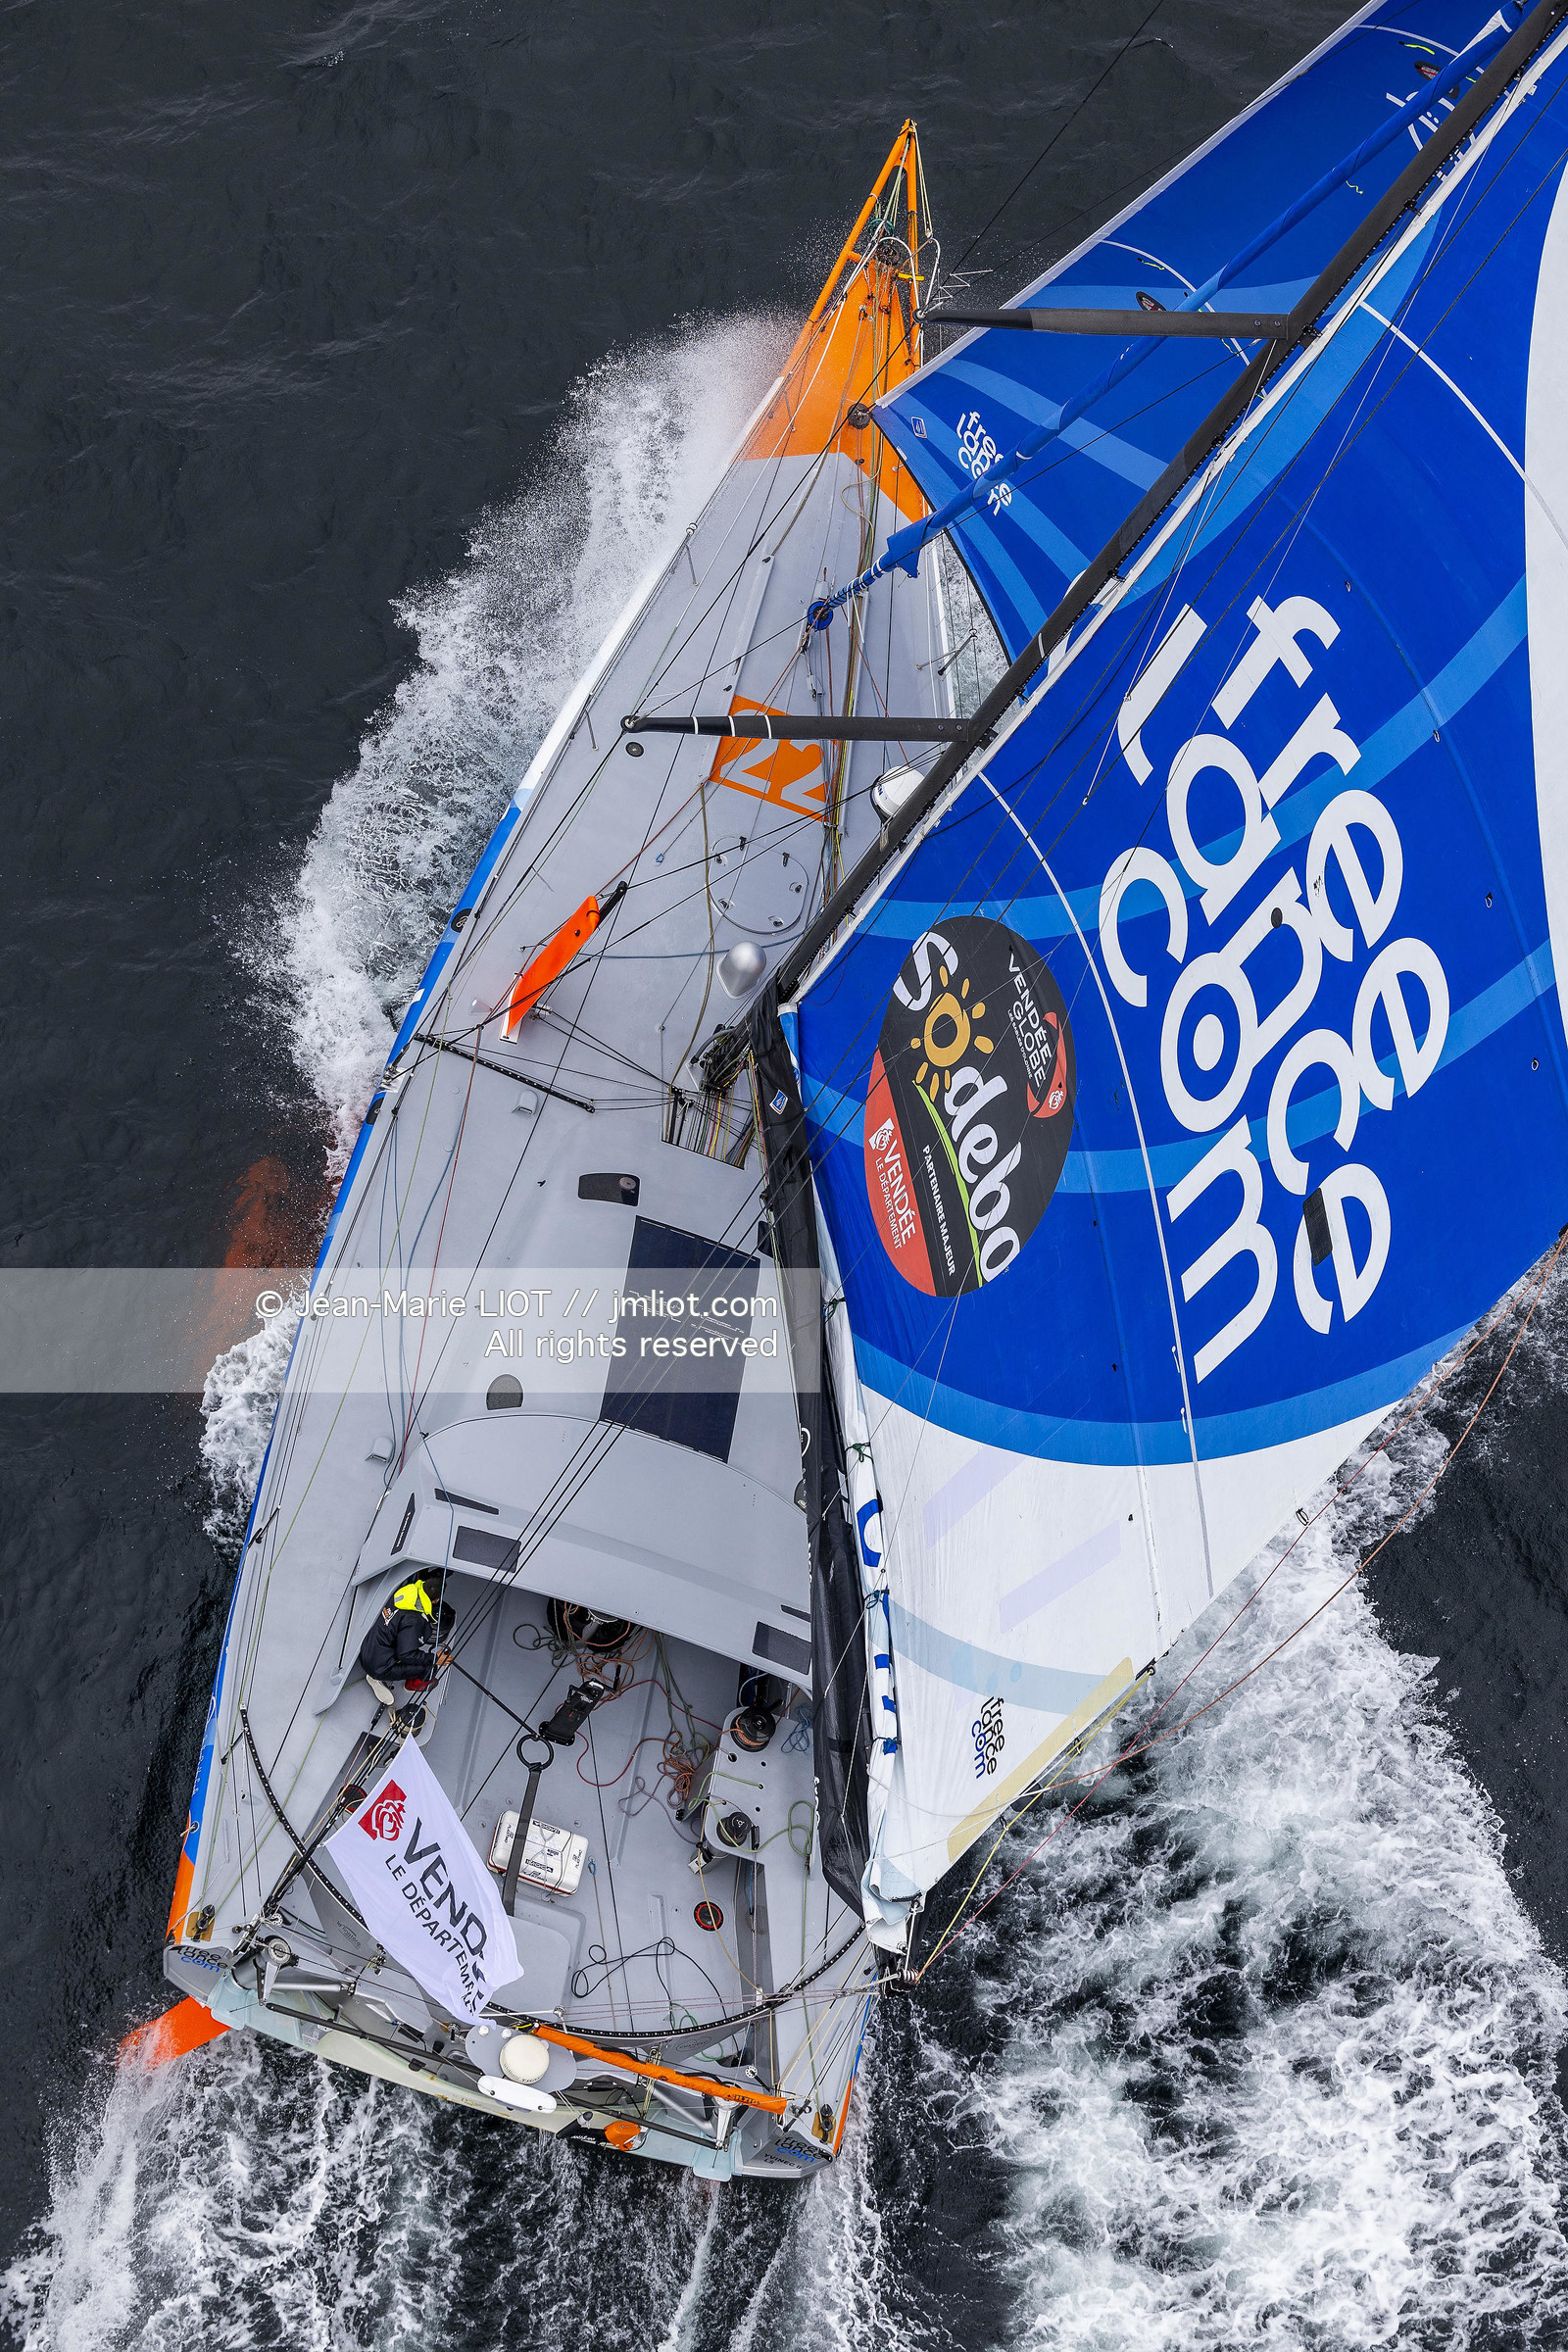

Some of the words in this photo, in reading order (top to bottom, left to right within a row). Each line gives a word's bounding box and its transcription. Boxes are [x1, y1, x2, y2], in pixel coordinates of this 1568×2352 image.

[956, 414, 1012, 507] lane
[1216, 595, 1450, 1112] free
[1008, 953, 1053, 1066] VENDÉE
[1118, 603, 1392, 1334] lance
[1012, 1001, 1047, 1088] GLOBE
[893, 931, 1021, 1283] Sodebo
[1099, 847, 1278, 1384] com
[875, 1156, 885, 1173] LE
[884, 1139, 916, 1246] VENDÉE
[878, 1172, 903, 1250] DÉPARTEMENT
[922, 1144, 946, 1224] PARTENAIRE
[938, 1221, 956, 1276] MAJEUR
[971, 1720, 986, 1780] com
[981, 1696, 998, 1776] lance
[990, 1697, 1005, 1753] free
[385, 1853, 407, 1882] LE
[404, 1817, 487, 2014] VEND
[180, 1956, 220, 1973] com
[775, 2139, 823, 2159] lance
[777, 2147, 814, 2164] com
[783, 2136, 819, 2152] free
